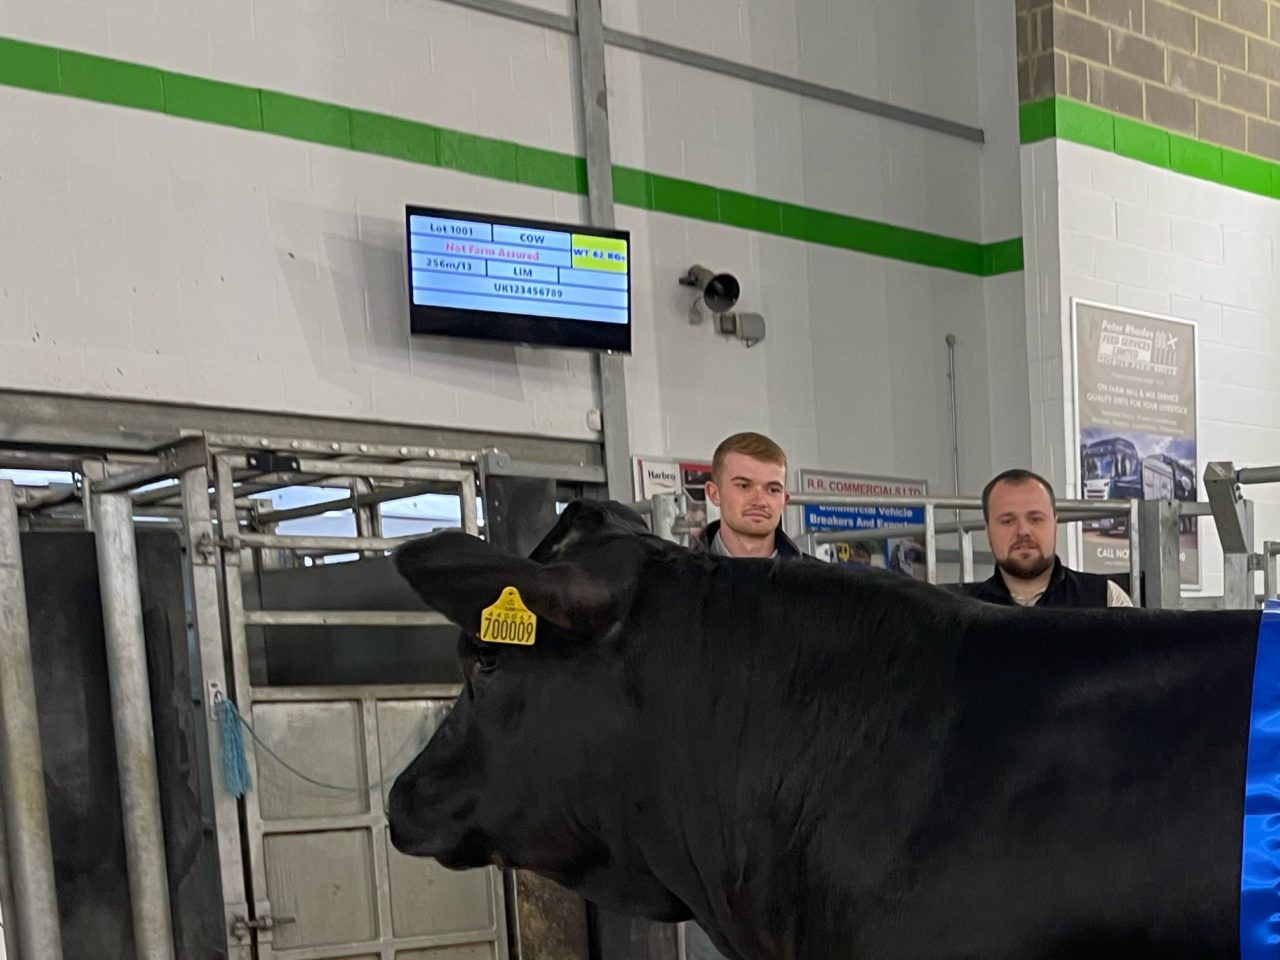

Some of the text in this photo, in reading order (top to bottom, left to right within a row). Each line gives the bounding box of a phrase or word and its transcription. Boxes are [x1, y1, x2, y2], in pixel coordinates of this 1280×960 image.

[429, 222, 473, 236] Lot 1001
[519, 233, 545, 244] COW
[446, 242, 540, 260] Not Farm Assured
[426, 257, 472, 272] 256m/13
[513, 266, 533, 277] LIM
[494, 282, 563, 298] UK123456789
[809, 514, 854, 528] Breakers
[856, 518, 875, 529] And
[1097, 548, 1114, 559] CALL
[483, 617, 534, 643] 700009
